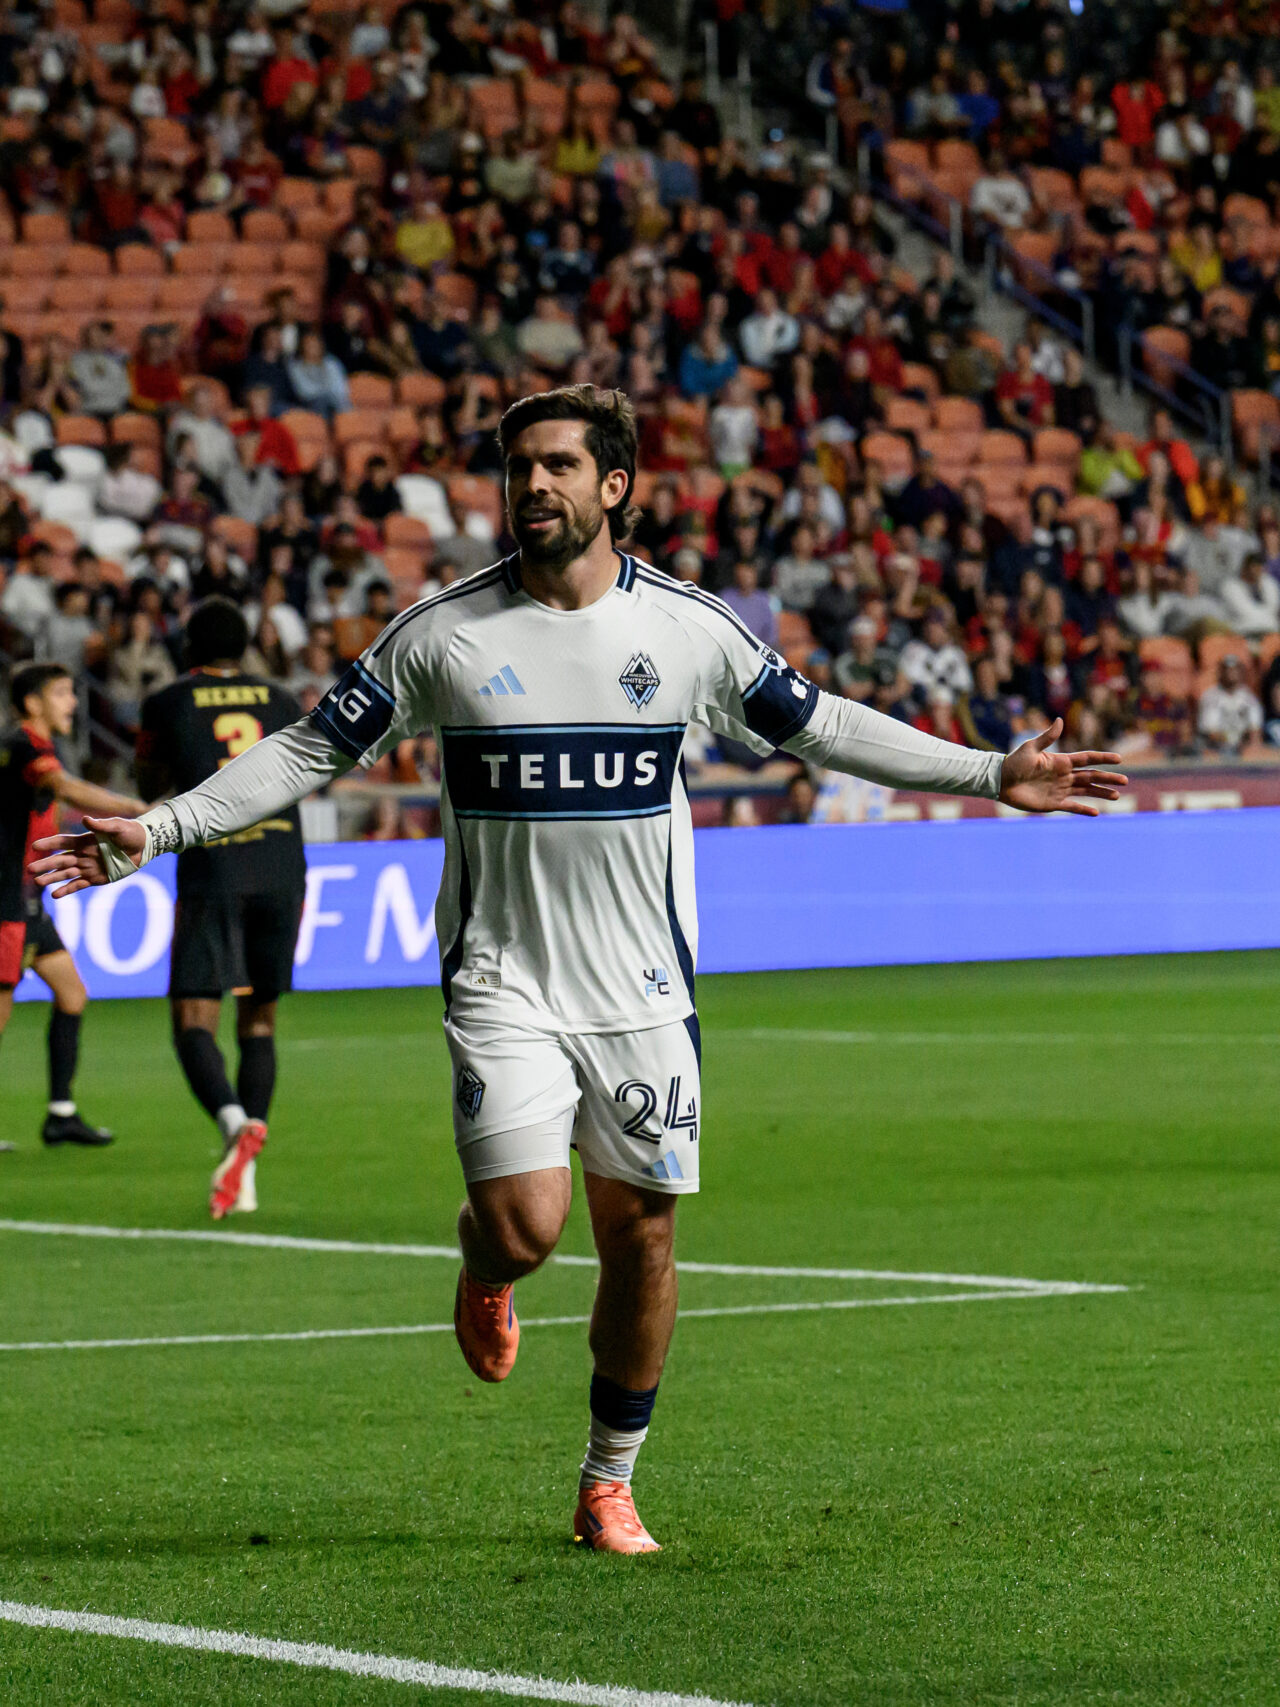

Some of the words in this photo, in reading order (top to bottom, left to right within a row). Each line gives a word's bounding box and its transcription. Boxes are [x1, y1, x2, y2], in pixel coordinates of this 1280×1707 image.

[620, 677, 659, 686] WHITECAPS
[481, 750, 659, 789] TELUS
[615, 1076, 697, 1145] 24
